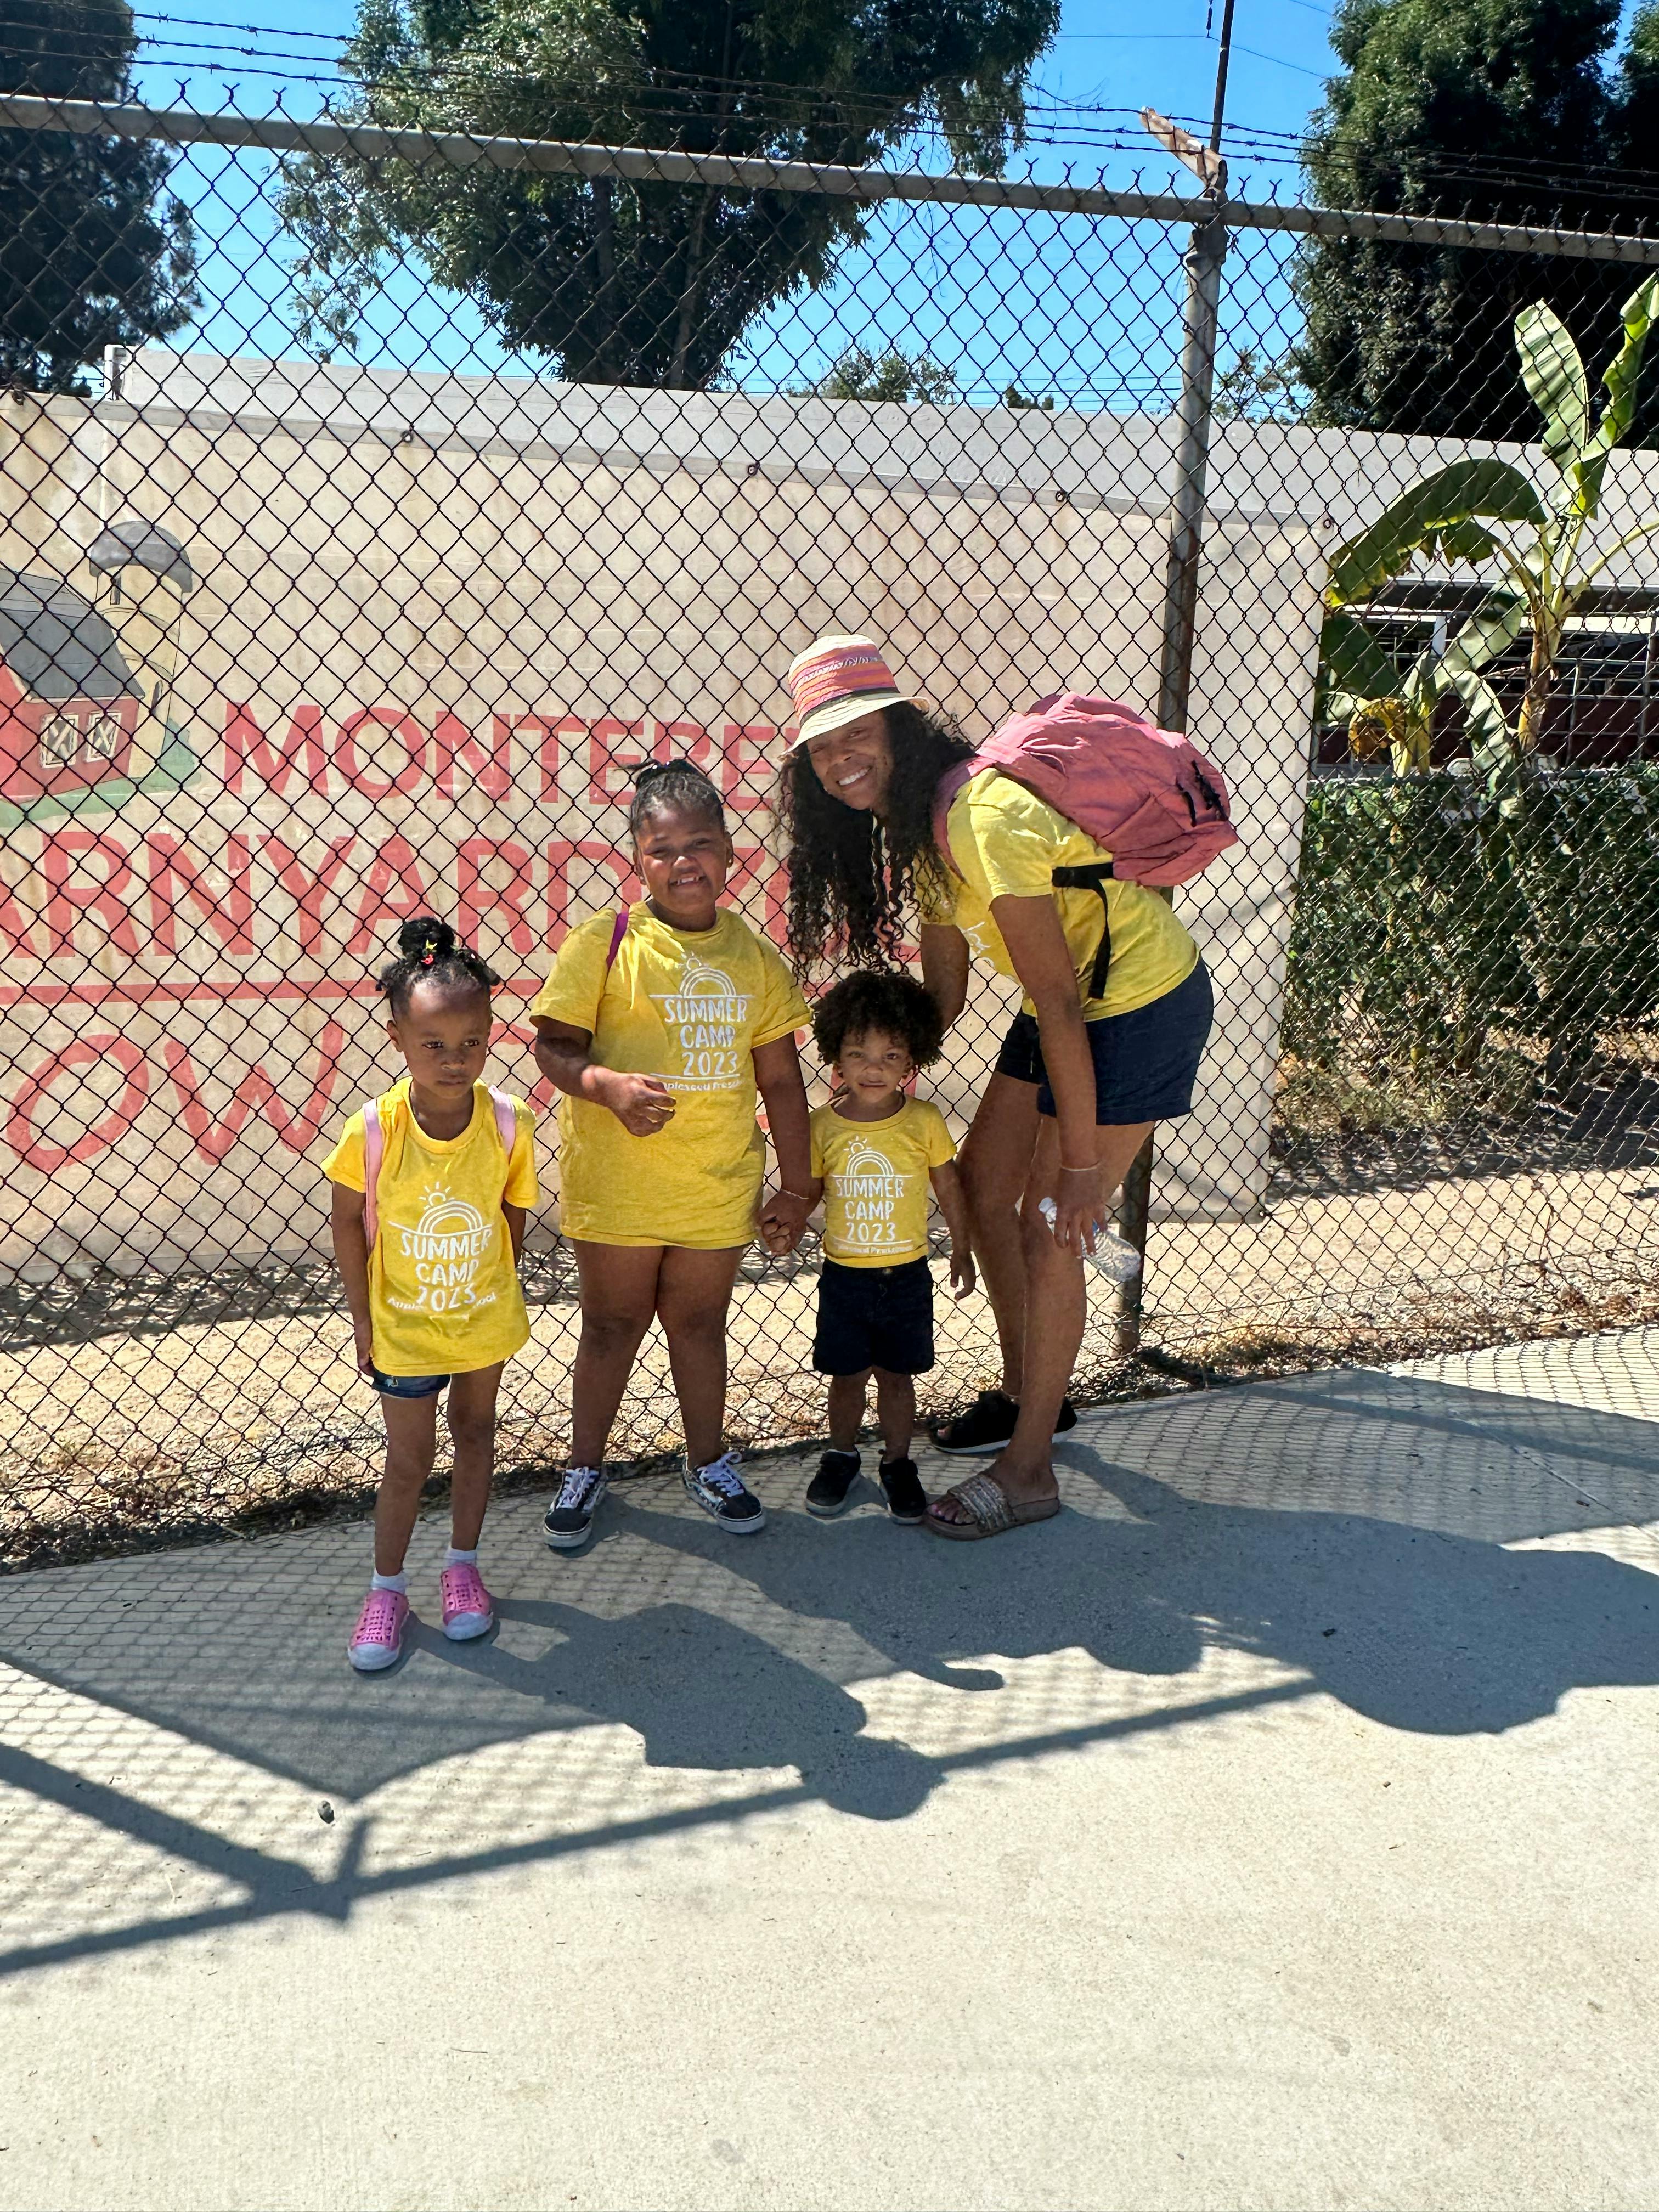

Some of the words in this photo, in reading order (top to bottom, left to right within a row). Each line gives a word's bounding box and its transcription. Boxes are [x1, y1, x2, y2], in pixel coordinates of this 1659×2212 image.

[664, 998, 747, 1023] SUMMER
[680, 1025, 736, 1048] CAMP
[682, 1052, 738, 1076] 2023
[835, 1178, 904, 1198] SUMMER
[845, 1200, 894, 1220] CAMP
[845, 1222, 895, 1242] 2023
[400, 1229, 492, 1260] SUMMER
[416, 1259, 479, 1286] CAMP
